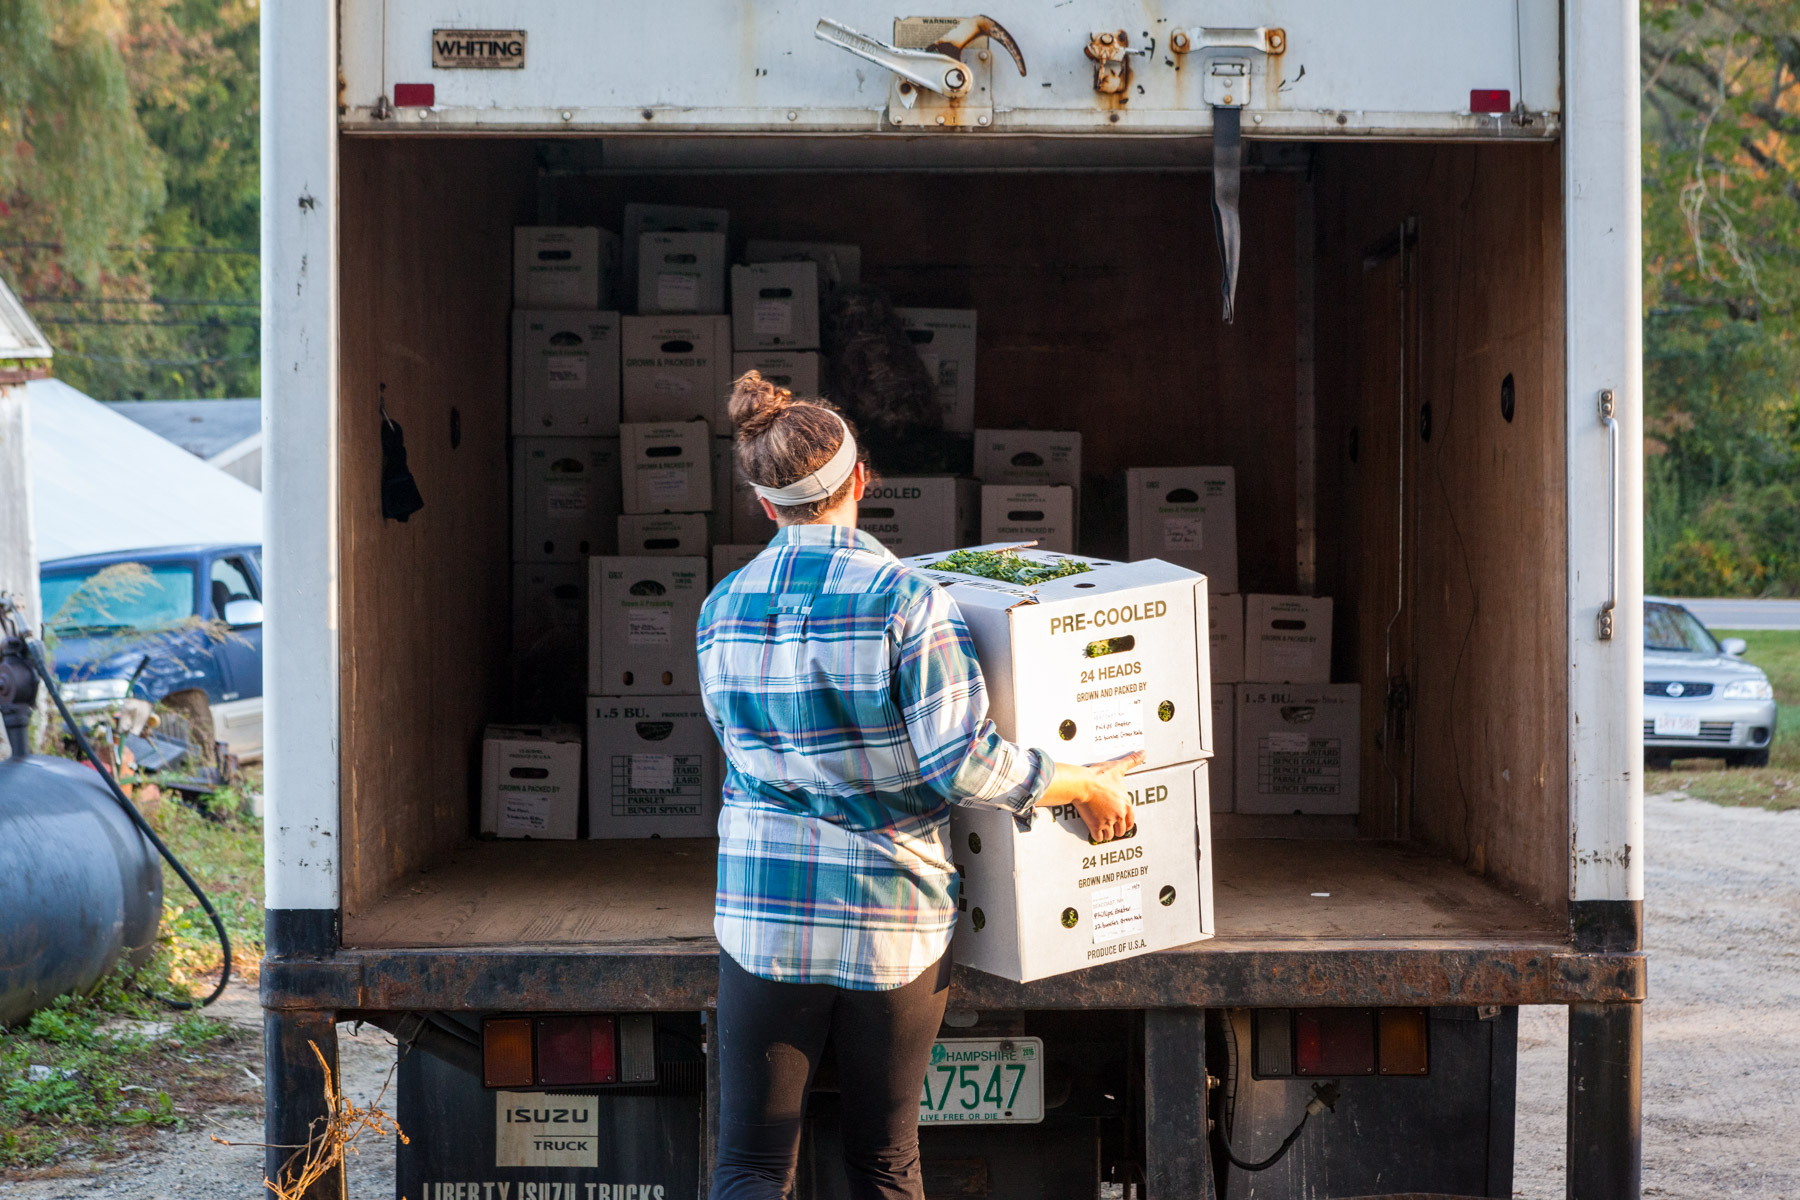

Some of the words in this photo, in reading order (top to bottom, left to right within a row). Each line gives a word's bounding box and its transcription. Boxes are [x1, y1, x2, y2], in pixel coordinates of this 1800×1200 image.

[435, 40, 522, 56] WHITING
[626, 358, 655, 367] GROWN
[657, 358, 663, 367] &
[664, 358, 695, 367] PACKED
[697, 358, 706, 367] BY
[863, 487, 921, 499] COOLED
[864, 524, 899, 533] HEADS
[1050, 600, 1168, 635] PRE-COOLED
[1080, 669, 1095, 684] 24
[1098, 661, 1142, 681] HEADS
[1076, 690, 1099, 703] GROWN
[1100, 687, 1113, 698] AND
[1114, 683, 1138, 696] PACKED
[1138, 681, 1147, 692] BY
[1244, 693, 1266, 704] 1.5
[1271, 693, 1294, 704] BU.
[596, 708, 619, 719] 1.5
[623, 708, 650, 719] BU.
[1272, 757, 1299, 765] BUNCH
[1301, 757, 1339, 765] COLLARD
[528, 785, 551, 793] PACKED
[627, 796, 665, 804] PARSLEY
[627, 806, 656, 814] BUNCH
[659, 806, 696, 814] SPINACH
[1082, 855, 1097, 870] 24
[1100, 845, 1143, 866] HEADS
[1078, 875, 1101, 889] GROWN
[1102, 872, 1114, 883] AND
[1116, 868, 1139, 881] PACKED
[1140, 865, 1149, 875] BY
[1087, 945, 1117, 960] PRODUCE
[1118, 942, 1127, 953] OF
[1128, 938, 1147, 951] U.S.A.
[946, 1050, 1017, 1062] HAMPSHIRE
[506, 1108, 589, 1124] ISUZU
[920, 1113, 939, 1121] LIVE
[984, 1112, 998, 1120] DIE
[533, 1140, 588, 1151] TRUCK
[422, 1181, 511, 1200] LIBERTY
[517, 1182, 577, 1200] ISUZU
[584, 1183, 666, 1200] TRUCKS
